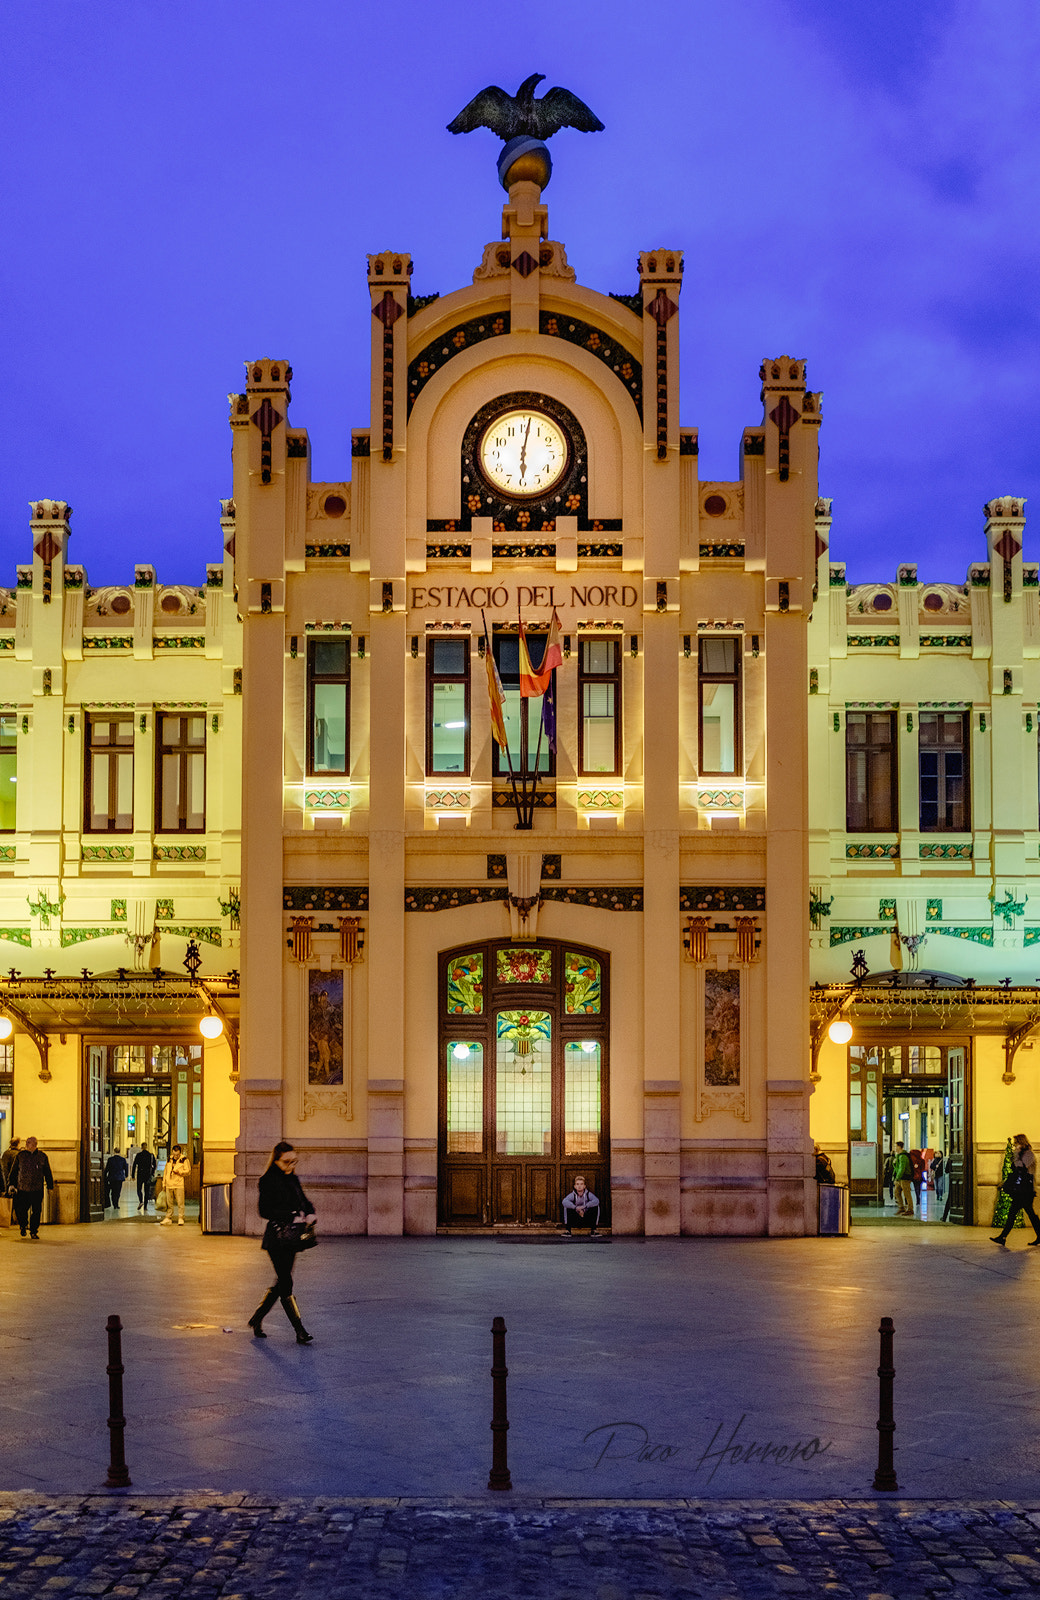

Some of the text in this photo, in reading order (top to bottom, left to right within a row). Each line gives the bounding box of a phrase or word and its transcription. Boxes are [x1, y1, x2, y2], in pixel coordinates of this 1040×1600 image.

[508, 427, 515, 437] 11
[495, 437, 507, 447] 10
[544, 436, 552, 447] 2
[492, 450, 500, 459] 9
[495, 463, 503, 473] 8
[542, 464, 550, 474] 4
[506, 474, 512, 484] 7
[518, 478, 527, 487] 6
[534, 474, 541, 484] 5
[411, 581, 638, 609] ESTACIÓ DEL NORD
